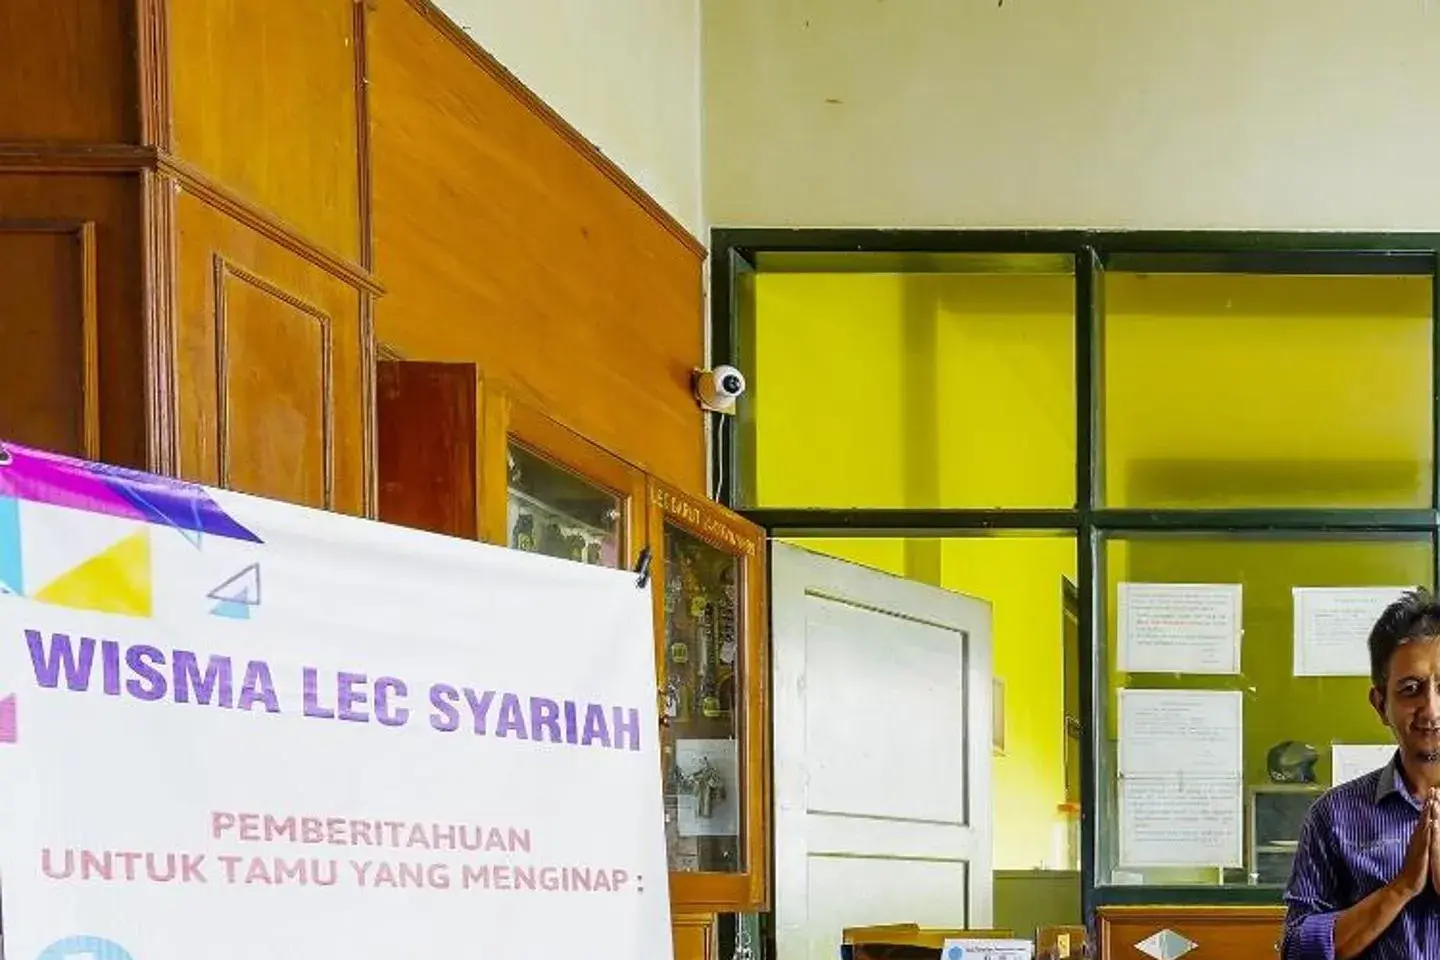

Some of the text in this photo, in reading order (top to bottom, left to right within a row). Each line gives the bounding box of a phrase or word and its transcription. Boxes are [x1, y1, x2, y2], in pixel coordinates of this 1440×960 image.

[24, 629, 641, 750] WISMA LEC SYARIAH
[210, 810, 531, 853] PEMBERITAHUAN
[42, 847, 208, 884] UNTUK
[218, 854, 337, 887] TAMU
[350, 860, 450, 890] YANG
[461, 863, 628, 893] MENGINAP
